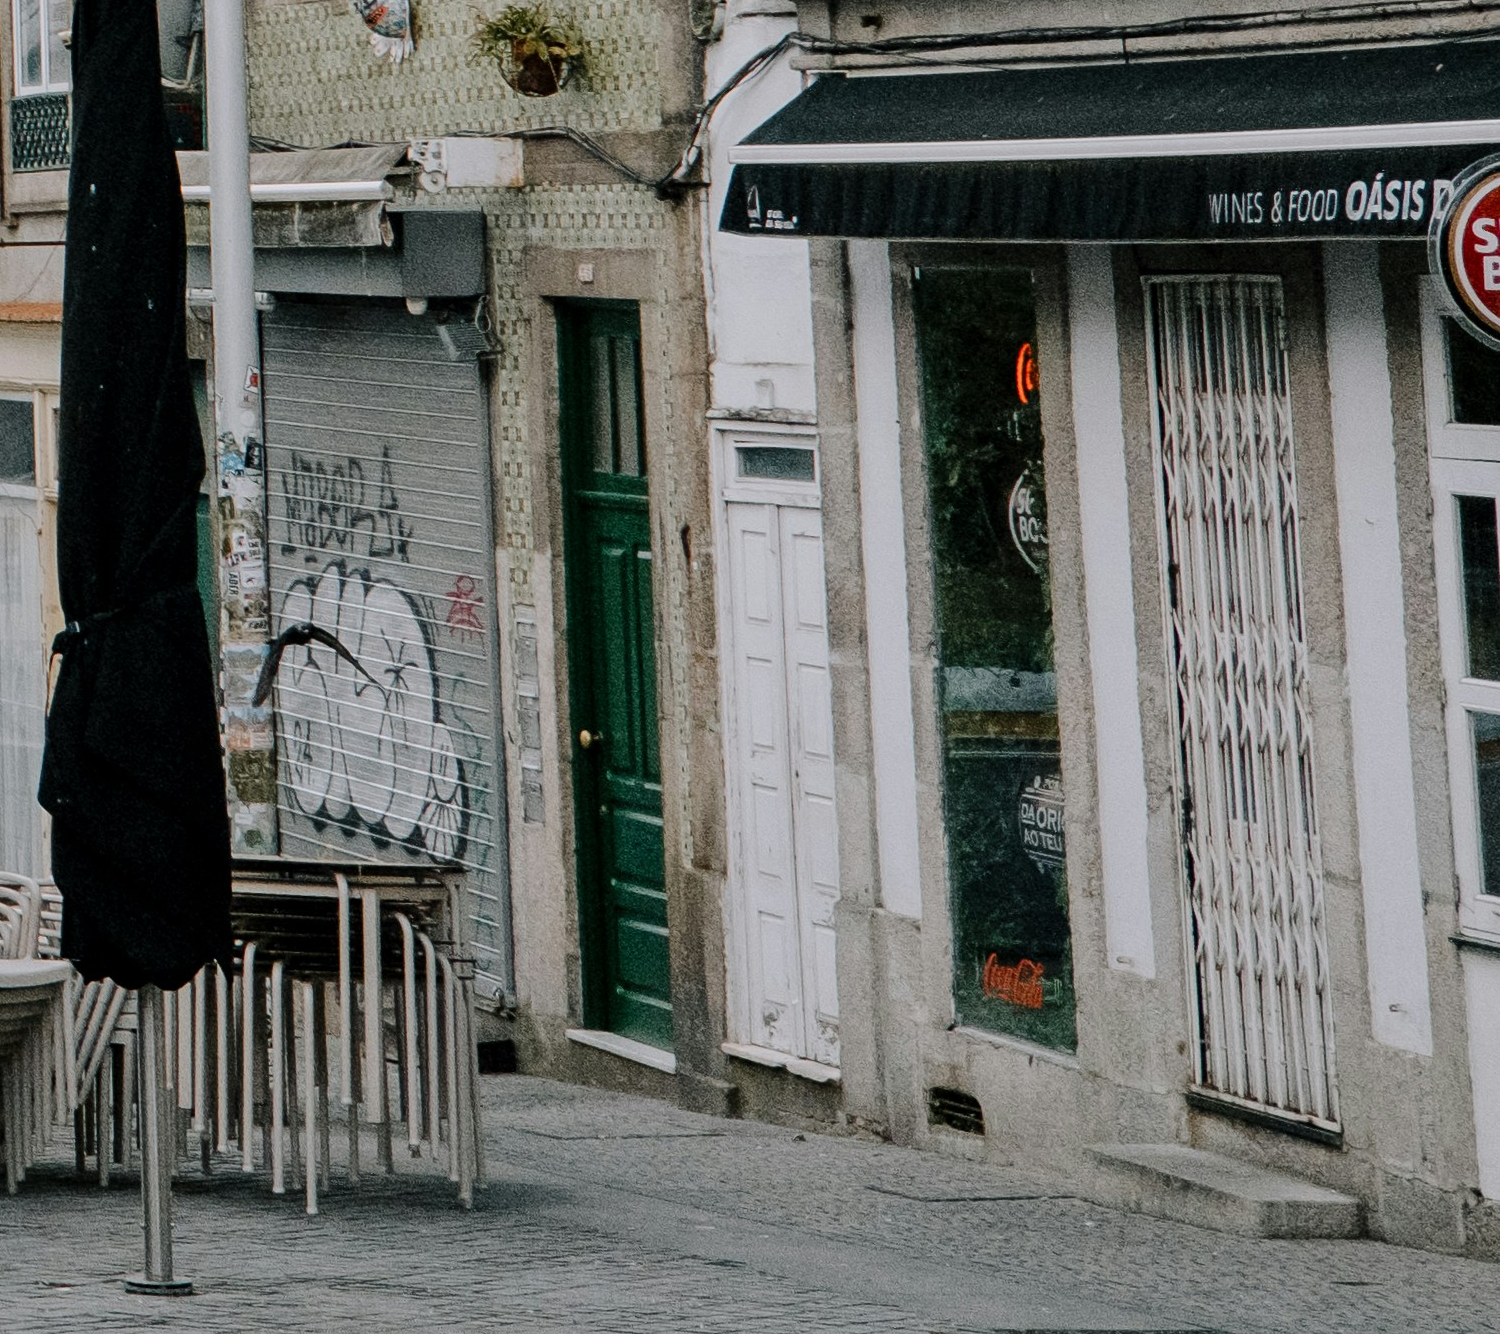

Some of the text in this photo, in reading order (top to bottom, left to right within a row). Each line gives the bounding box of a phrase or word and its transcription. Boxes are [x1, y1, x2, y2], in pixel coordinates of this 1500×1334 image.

[1209, 192, 1263, 224] WINES
[1271, 191, 1283, 223] &
[1288, 189, 1338, 222] FOOD
[1346, 171, 1426, 221] OÁSIS
[1037, 806, 1064, 833] ORI
